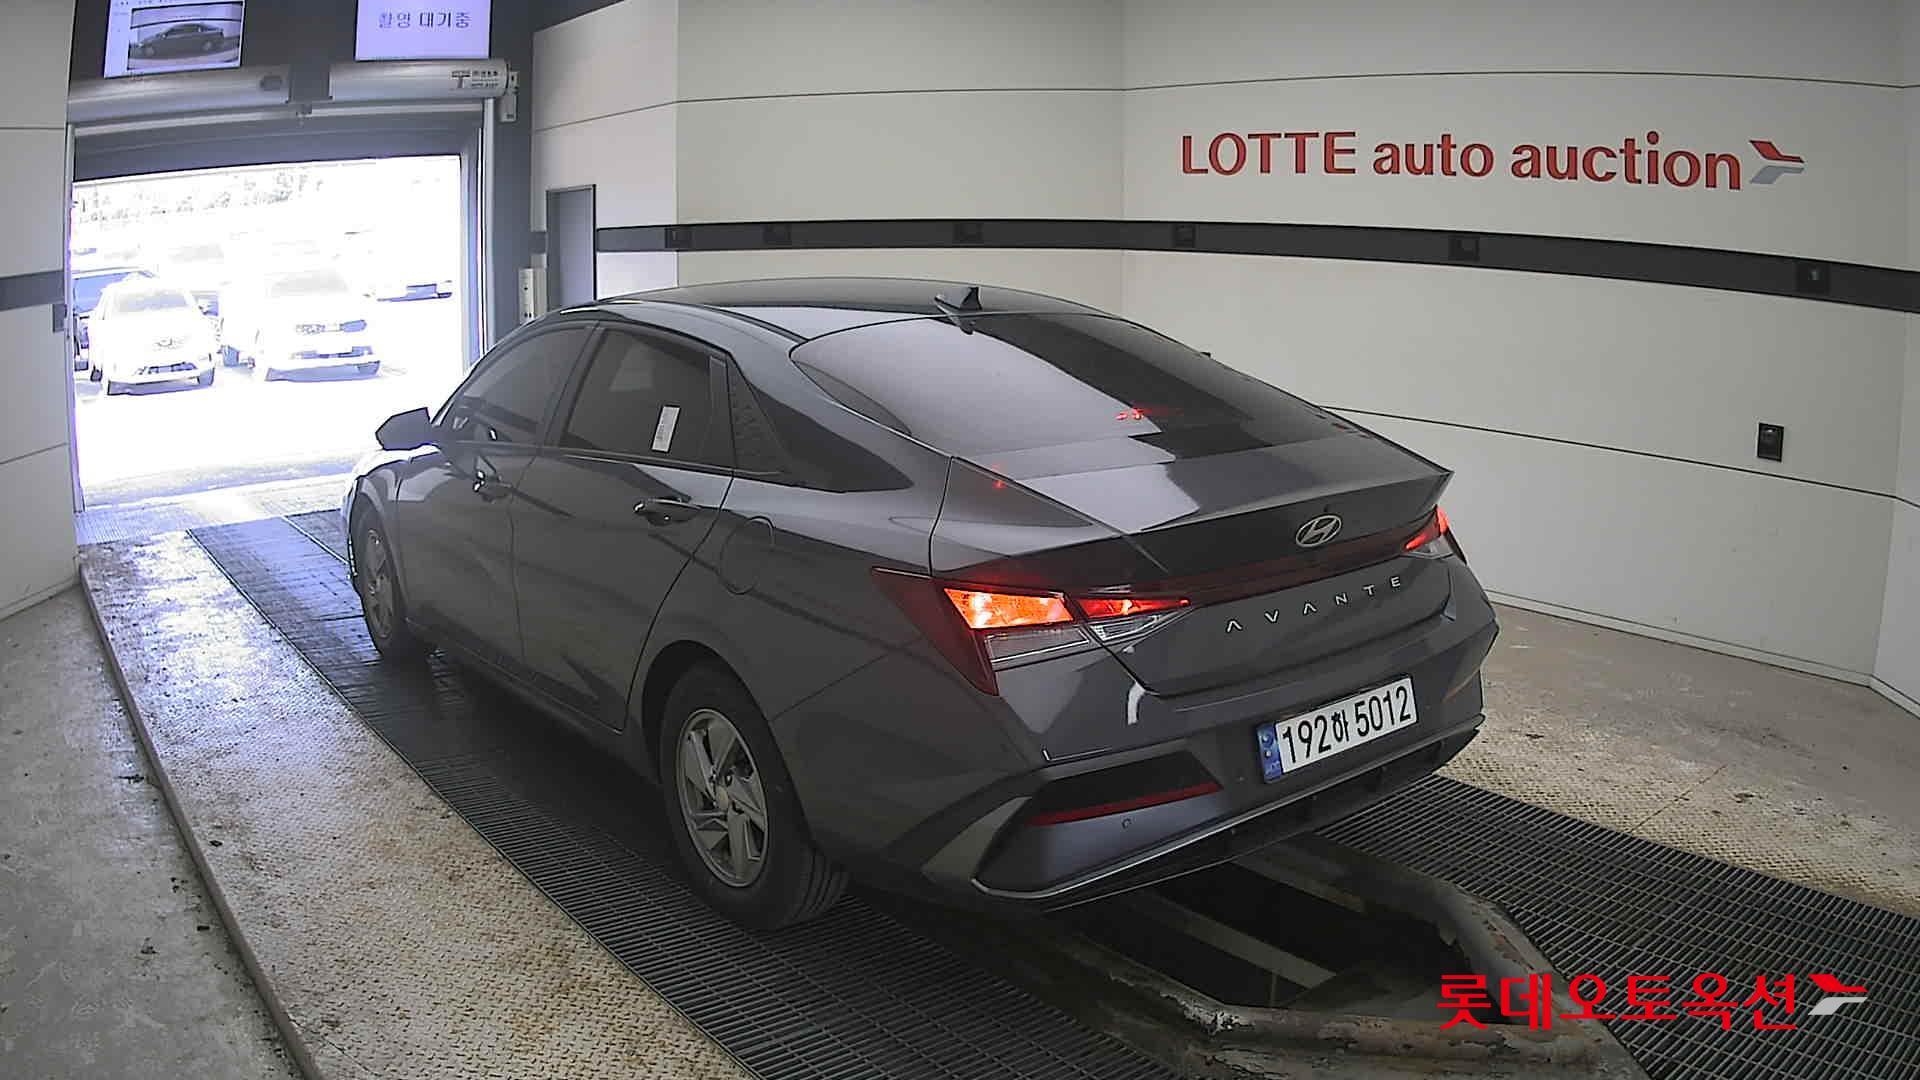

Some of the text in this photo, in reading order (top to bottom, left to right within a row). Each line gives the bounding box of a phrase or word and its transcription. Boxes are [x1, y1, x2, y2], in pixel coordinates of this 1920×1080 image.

[419, 11, 472, 29] 대기중
[1182, 131, 1742, 191] LOTTE auto auction
[1226, 575, 1402, 633] AVANTE
[1354, 685, 1412, 738] 5012
